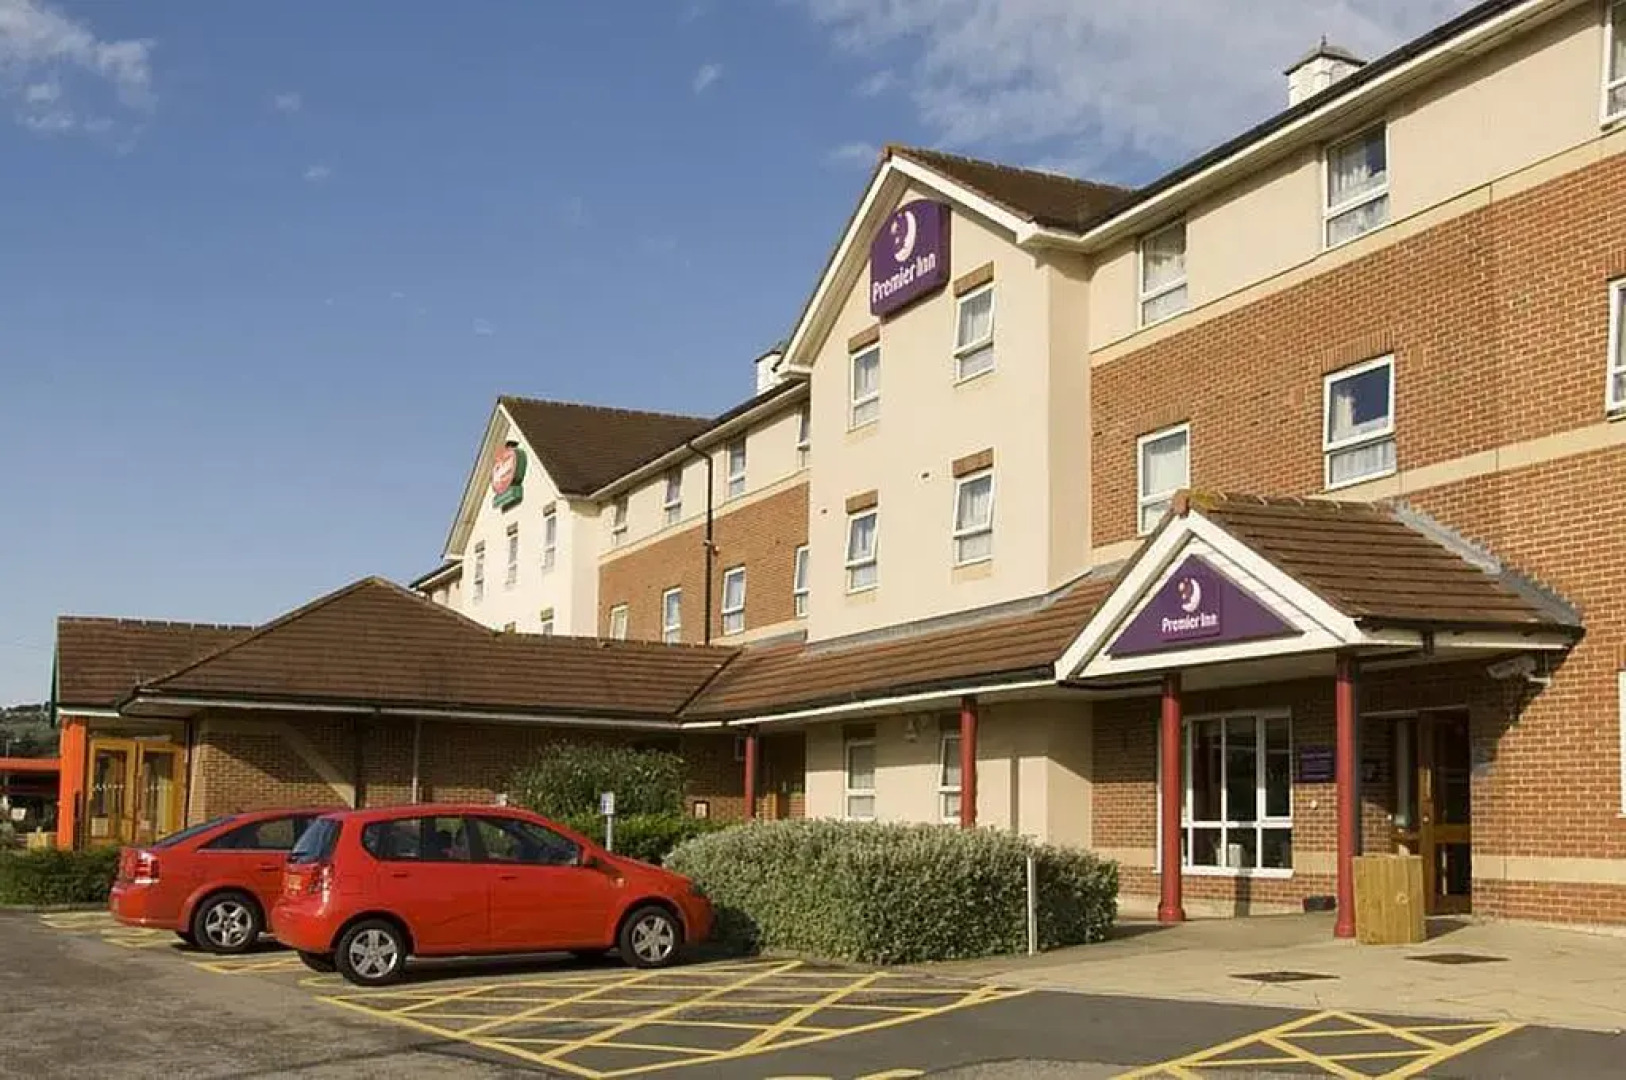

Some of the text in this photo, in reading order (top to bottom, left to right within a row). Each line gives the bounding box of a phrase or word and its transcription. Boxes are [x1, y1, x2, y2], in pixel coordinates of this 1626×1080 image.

[872, 253, 936, 303] Premier Inn
[1162, 612, 1218, 633] Premier Inn
